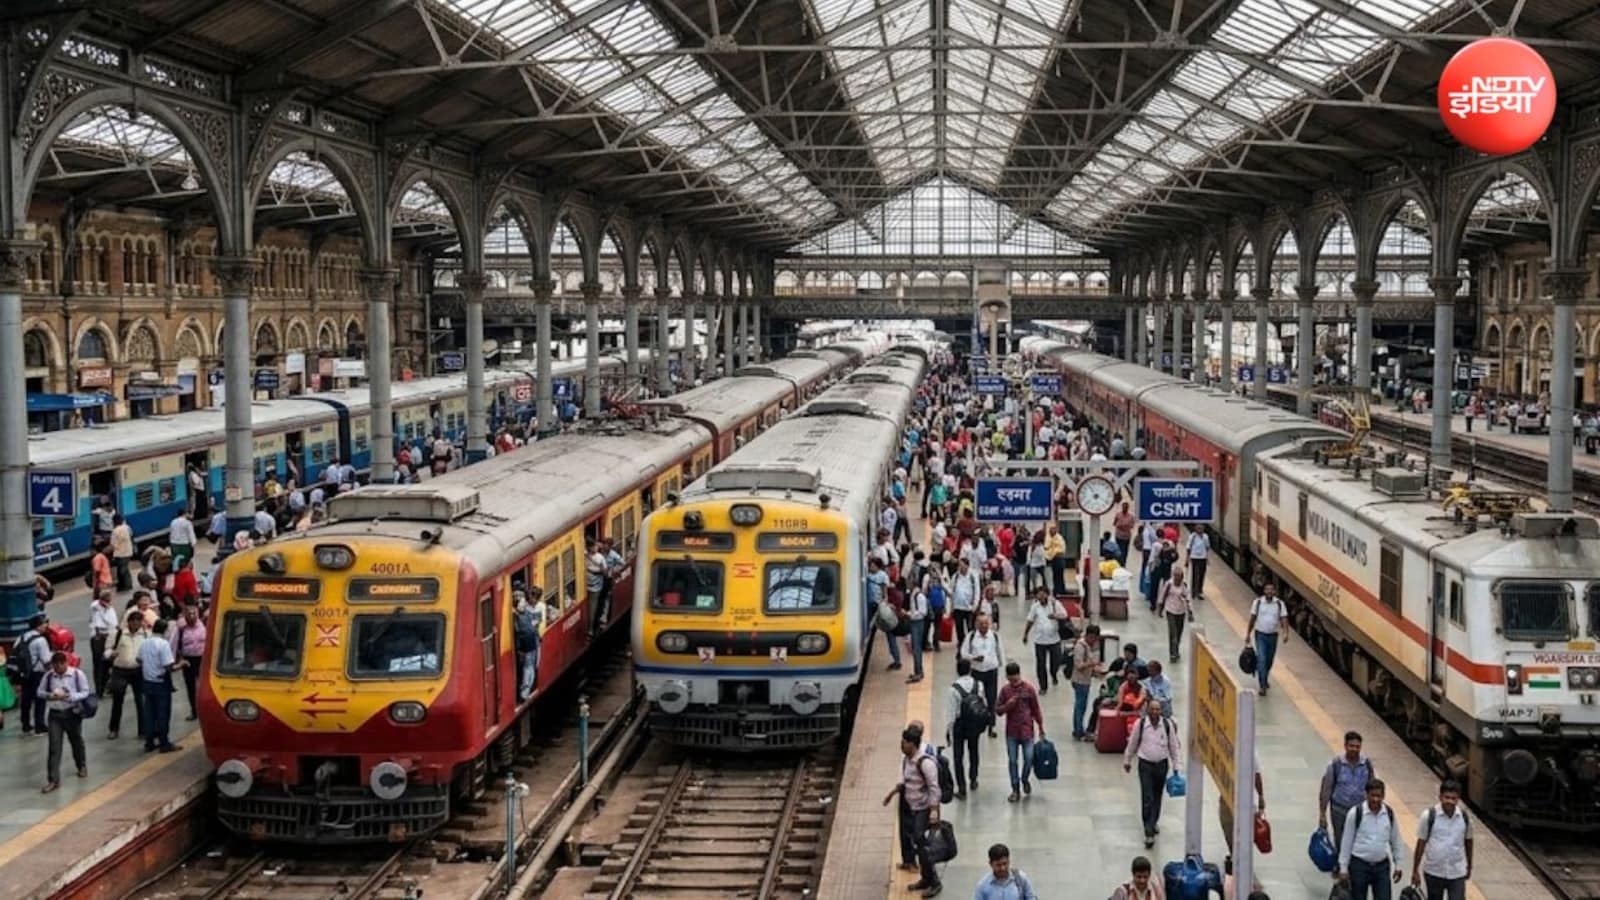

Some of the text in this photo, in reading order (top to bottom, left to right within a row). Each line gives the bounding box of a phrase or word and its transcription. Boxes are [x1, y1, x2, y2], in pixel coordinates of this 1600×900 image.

[41, 486, 63, 513] 4
[1150, 502, 1201, 517] CSMT
[370, 563, 411, 575] 4001A
